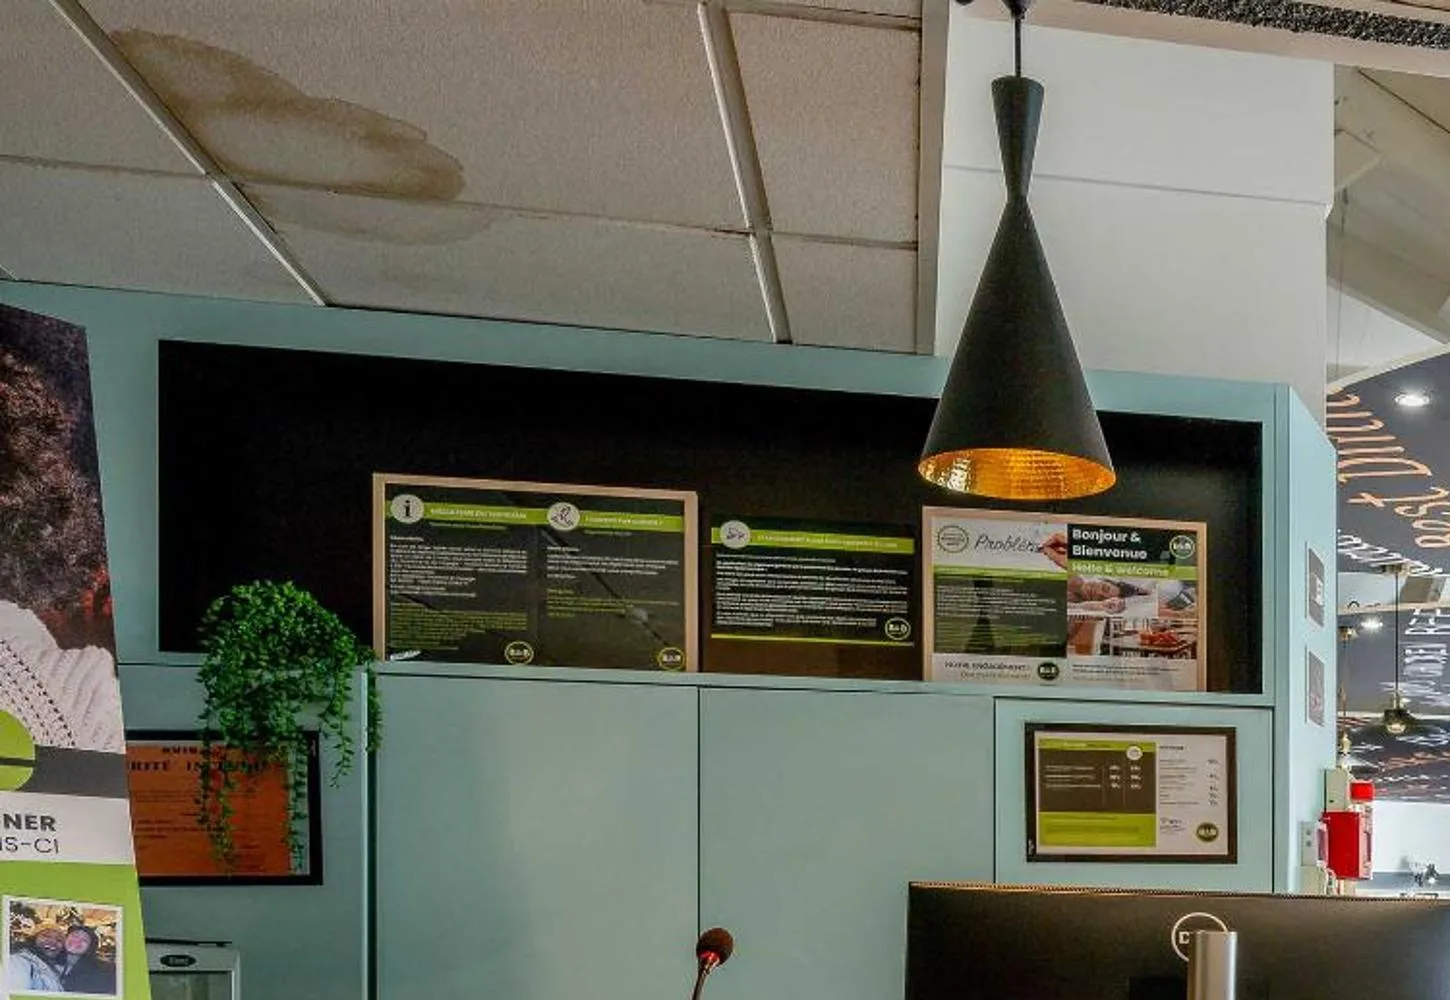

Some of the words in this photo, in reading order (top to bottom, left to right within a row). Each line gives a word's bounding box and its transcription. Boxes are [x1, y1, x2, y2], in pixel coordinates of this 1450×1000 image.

[1072, 529, 1129, 544] Bonjour
[1072, 545, 1148, 560] Bienvenue
[3, 813, 57, 832] NER
